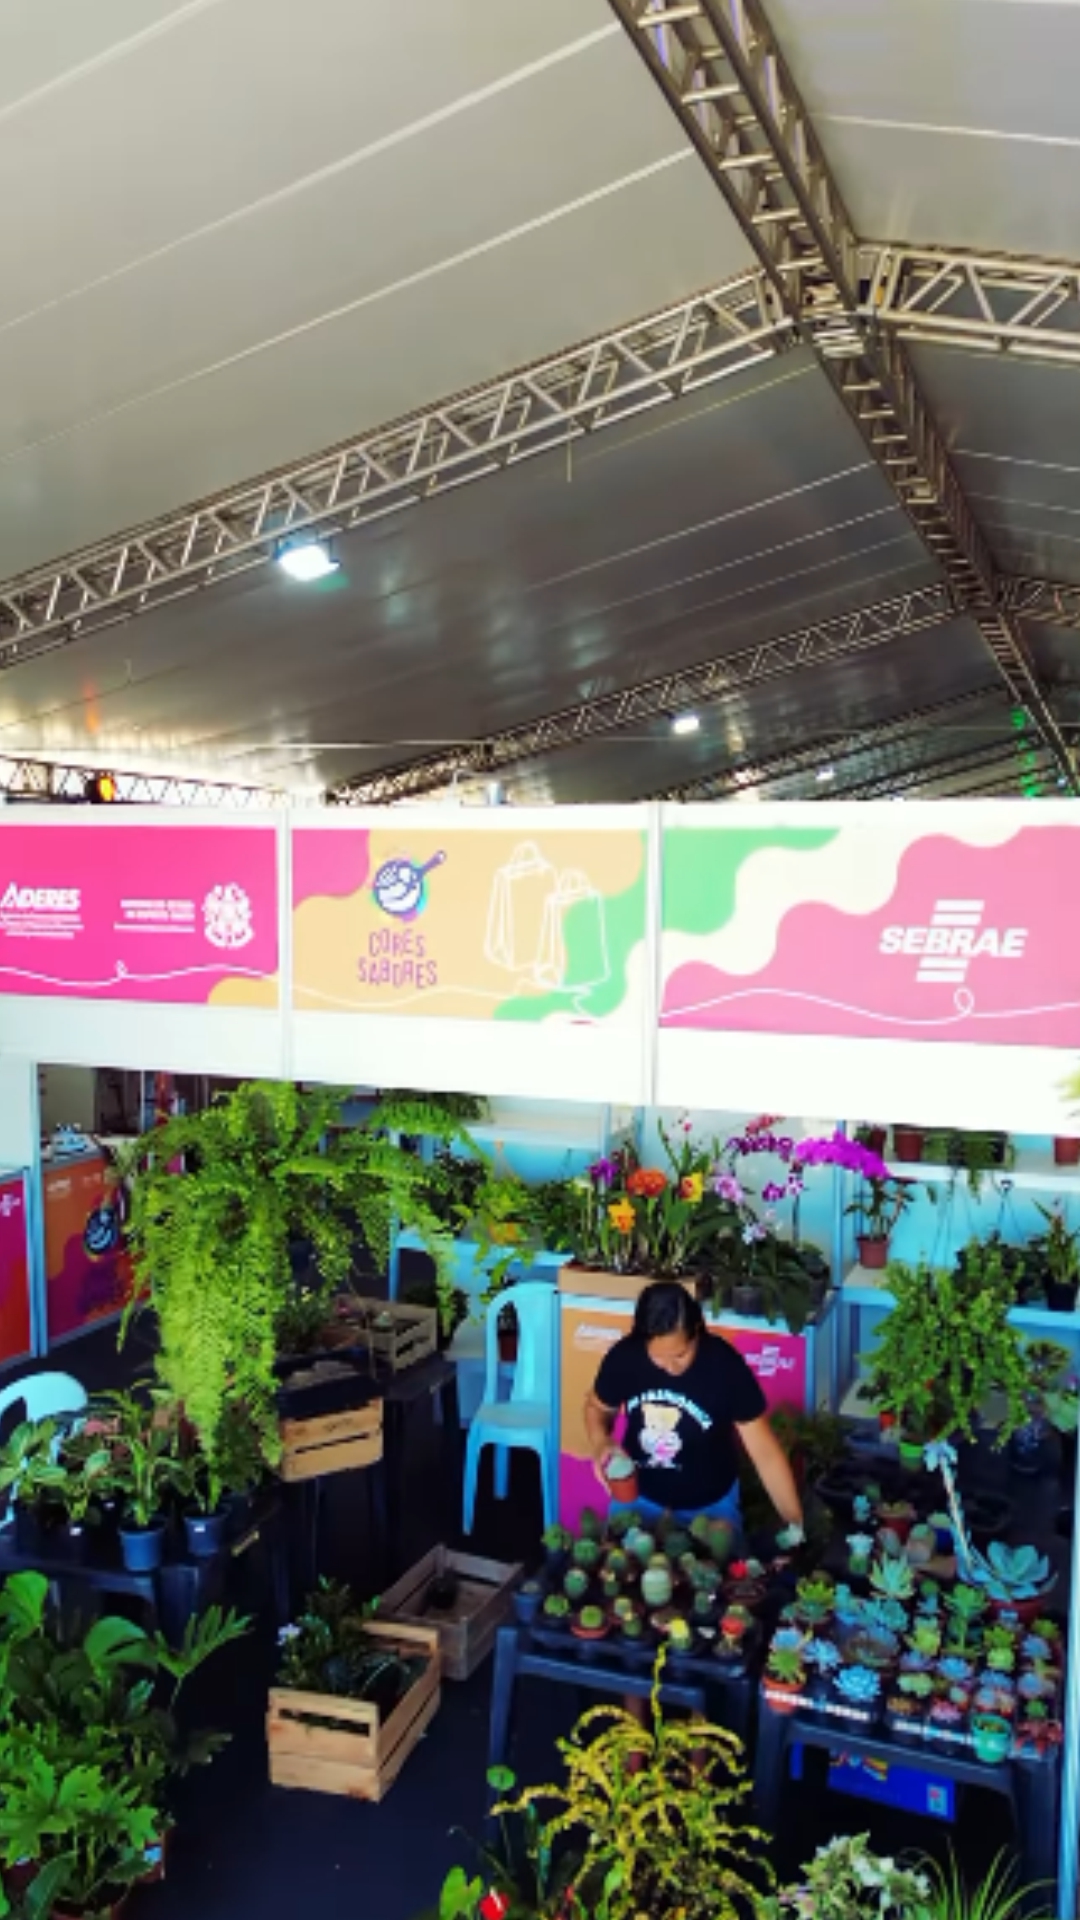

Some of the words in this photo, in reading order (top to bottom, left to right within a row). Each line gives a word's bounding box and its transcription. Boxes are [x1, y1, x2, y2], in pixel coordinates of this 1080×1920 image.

[0, 881, 81, 912] ADERES
[368, 927, 425, 957] CORES
[879, 925, 1028, 957] SEBRAE
[357, 956, 437, 989] SABORES
